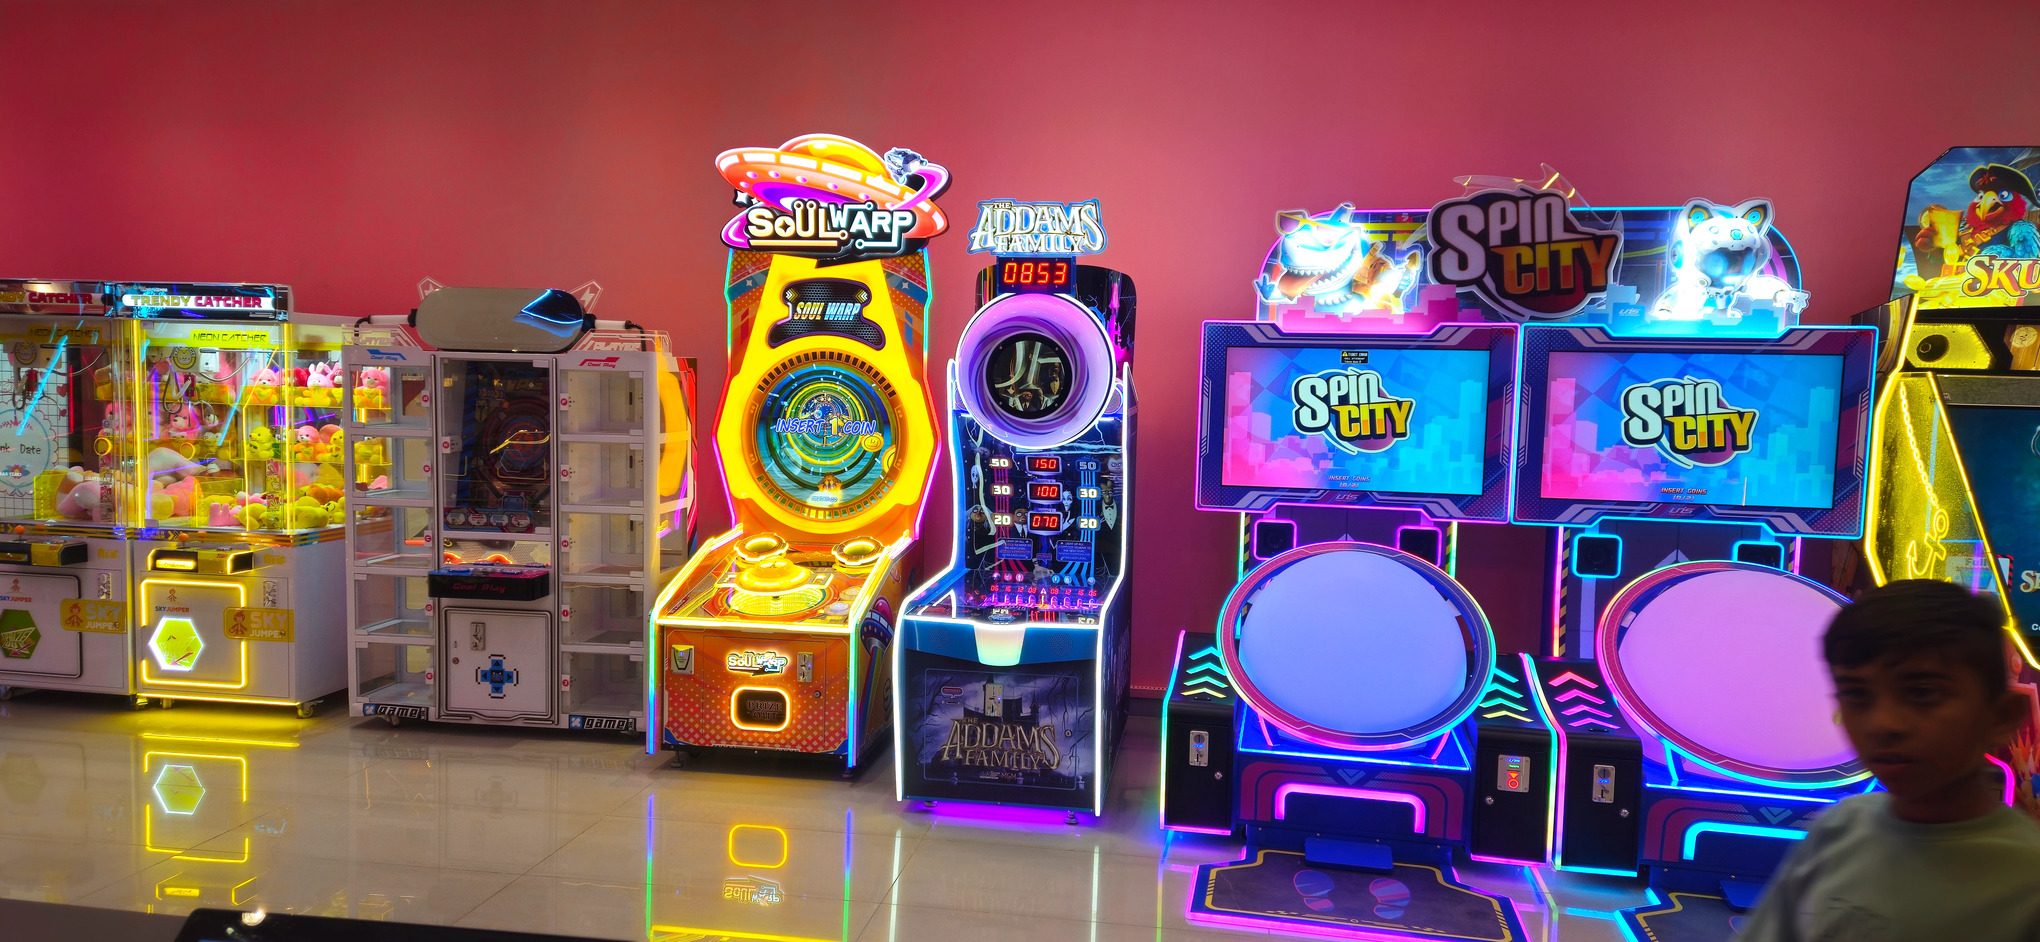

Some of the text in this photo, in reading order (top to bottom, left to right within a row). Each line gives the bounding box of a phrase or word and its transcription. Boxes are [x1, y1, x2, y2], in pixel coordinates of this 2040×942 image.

[970, 201, 1104, 252] ADDAMS
[993, 234, 1084, 253] FAMILY
[1440, 196, 1594, 281] SPIN
[1003, 262, 1067, 284] 0853
[1490, 238, 1615, 295] CITY
[131, 295, 262, 308] TRENDY CATCHER
[793, 301, 861, 321] SOUL WARP
[193, 333, 267, 343] NEON CATCHER
[1299, 373, 1397, 428] SPIN
[1331, 401, 1411, 437] CITY
[1628, 382, 1738, 440] SPIN
[776, 417, 877, 436] INSERT 1 COIN
[1664, 412, 1754, 450] CITY
[20, 443, 42, 455] Date
[990, 458, 1010, 468] 50
[1035, 459, 1057, 470] 150
[1079, 461, 1098, 471] 50
[993, 485, 1012, 496] 30
[1037, 486, 1058, 497] 100
[1079, 488, 1098, 499] 30
[994, 515, 1012, 525] 20
[1032, 515, 1058, 528] 070
[1079, 518, 1098, 529] 20
[86, 603, 121, 620] SKY
[251, 612, 288, 628] SKY
[747, 700, 783, 711] PRIZE
[940, 718, 1060, 770] ADDAMS
[964, 748, 1041, 770] FAMILY
